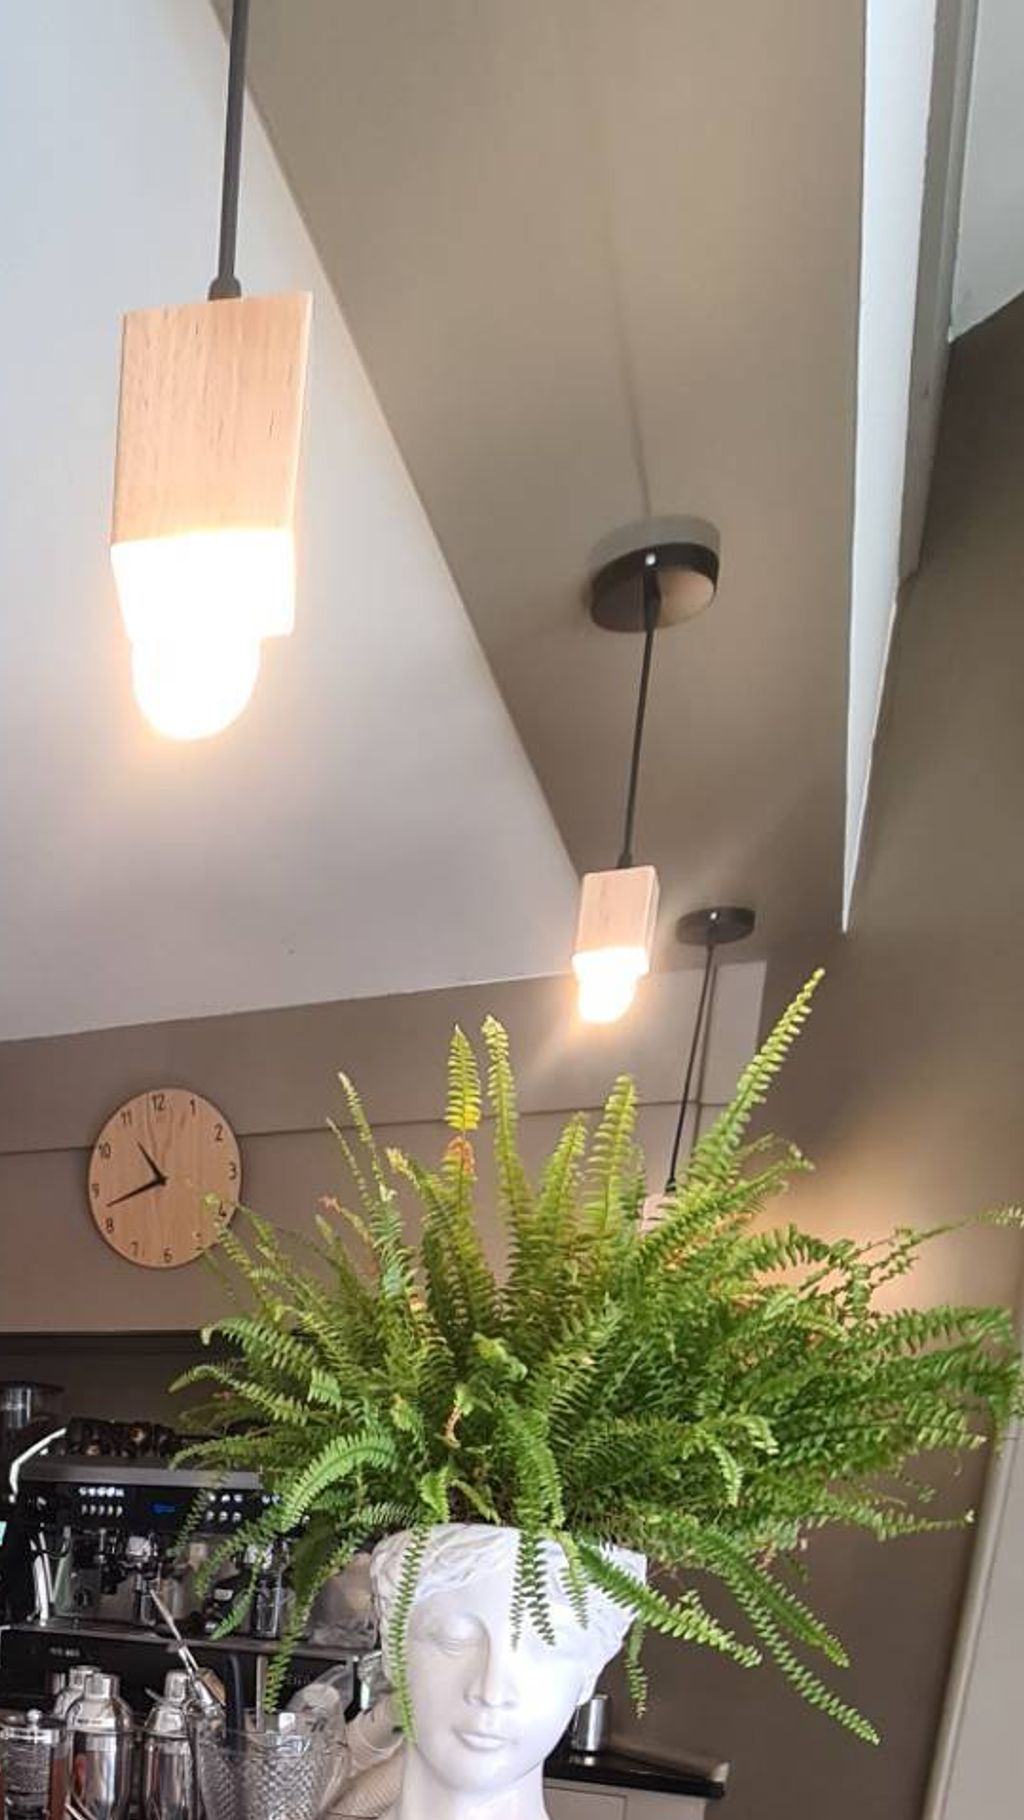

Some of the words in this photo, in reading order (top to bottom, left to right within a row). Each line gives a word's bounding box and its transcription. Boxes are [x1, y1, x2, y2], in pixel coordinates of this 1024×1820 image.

[151, 1093, 165, 1112] 12
[190, 1099, 196, 1115] 1
[120, 1110, 133, 1126] 11
[214, 1123, 223, 1141] 2
[98, 1141, 111, 1159] 10
[228, 1162, 237, 1180] 3
[105, 1217, 114, 1233] 8
[163, 1248, 173, 1263] 6
